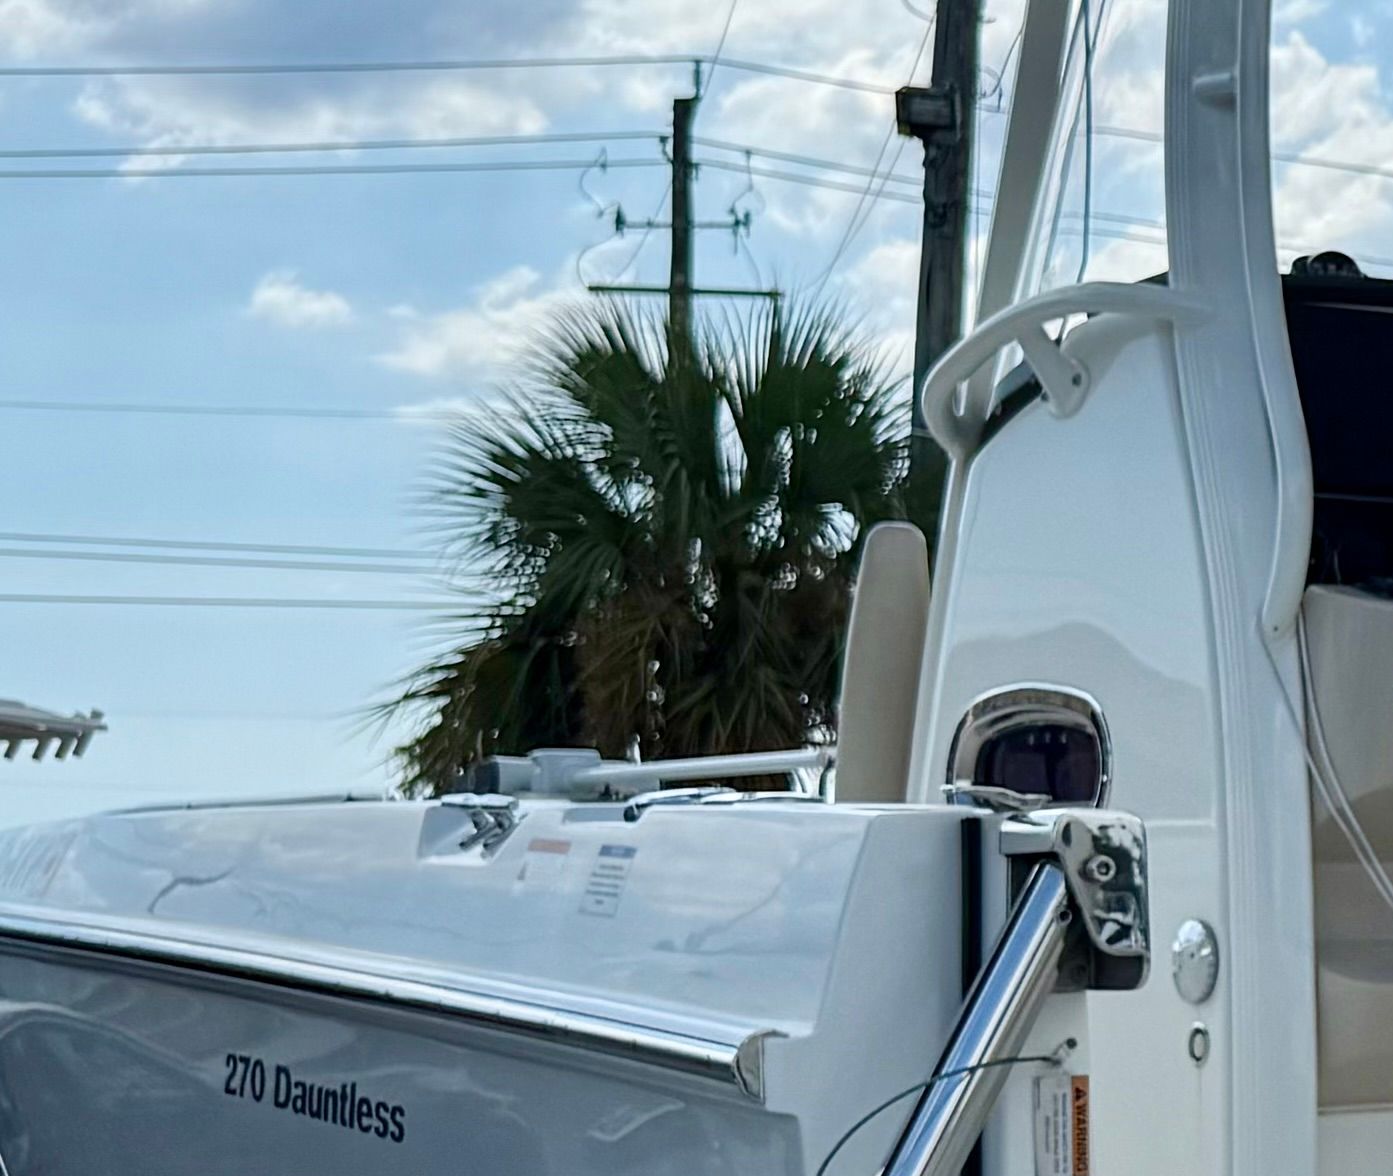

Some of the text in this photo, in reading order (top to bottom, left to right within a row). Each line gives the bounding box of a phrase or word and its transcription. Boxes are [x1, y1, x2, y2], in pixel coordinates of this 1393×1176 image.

[224, 1053, 406, 1144] 270 Dauntless
[1075, 1103, 1088, 1172] WARNING
